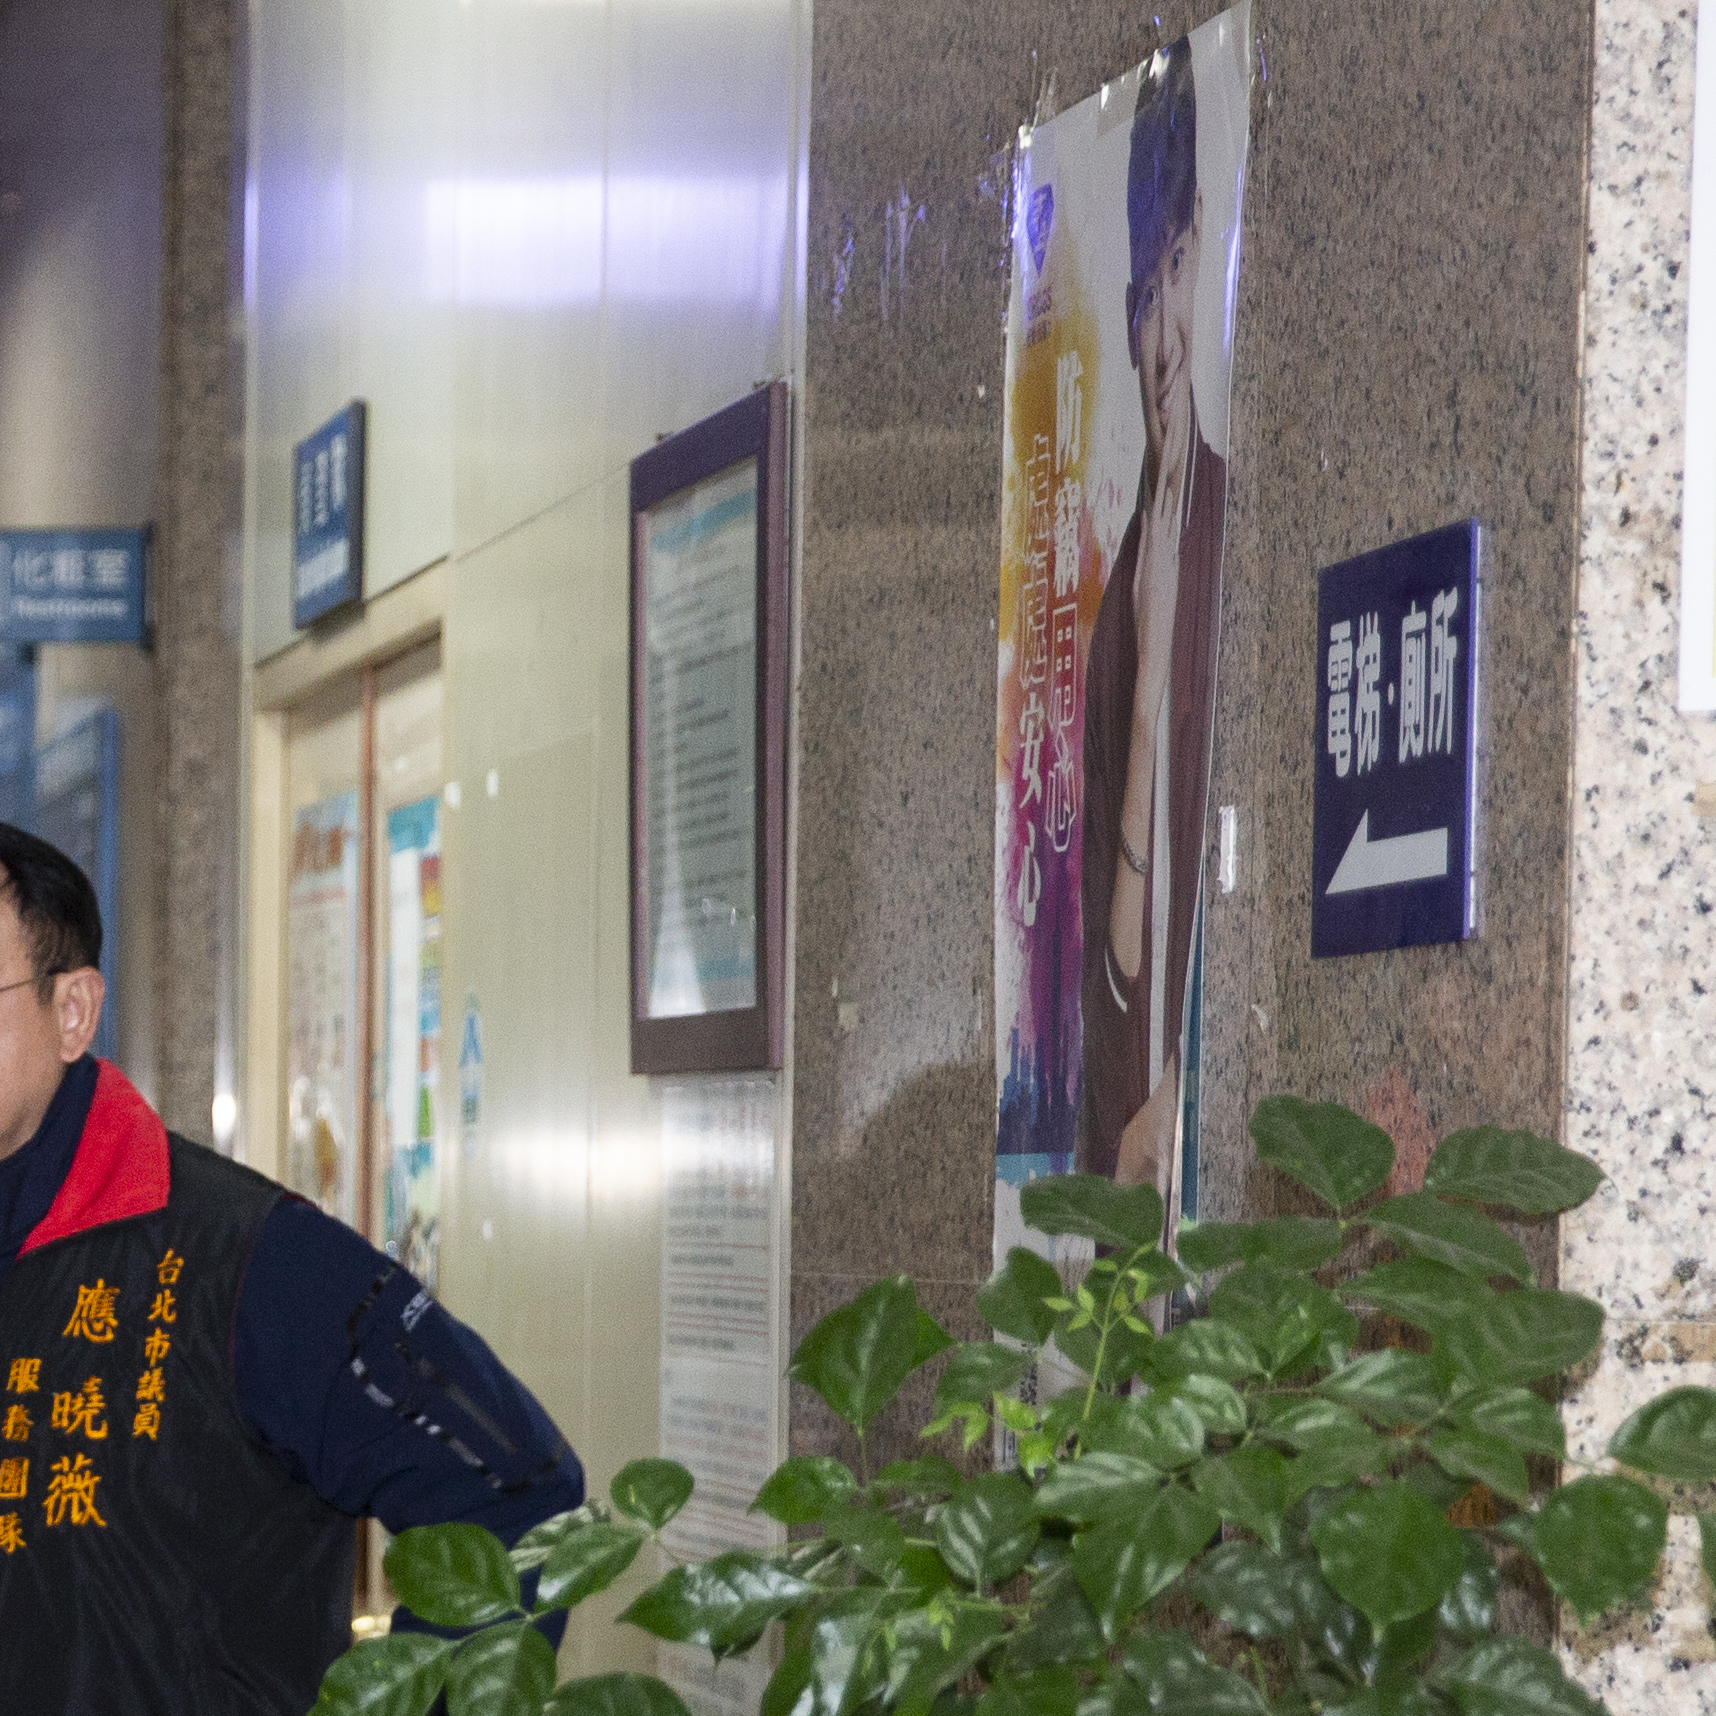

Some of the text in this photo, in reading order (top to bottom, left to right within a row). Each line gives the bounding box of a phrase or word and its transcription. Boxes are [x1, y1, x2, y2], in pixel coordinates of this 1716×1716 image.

[41, 1278, 121, 1528] 應曉薇
[132, 1248, 185, 1441] 台北市議員
